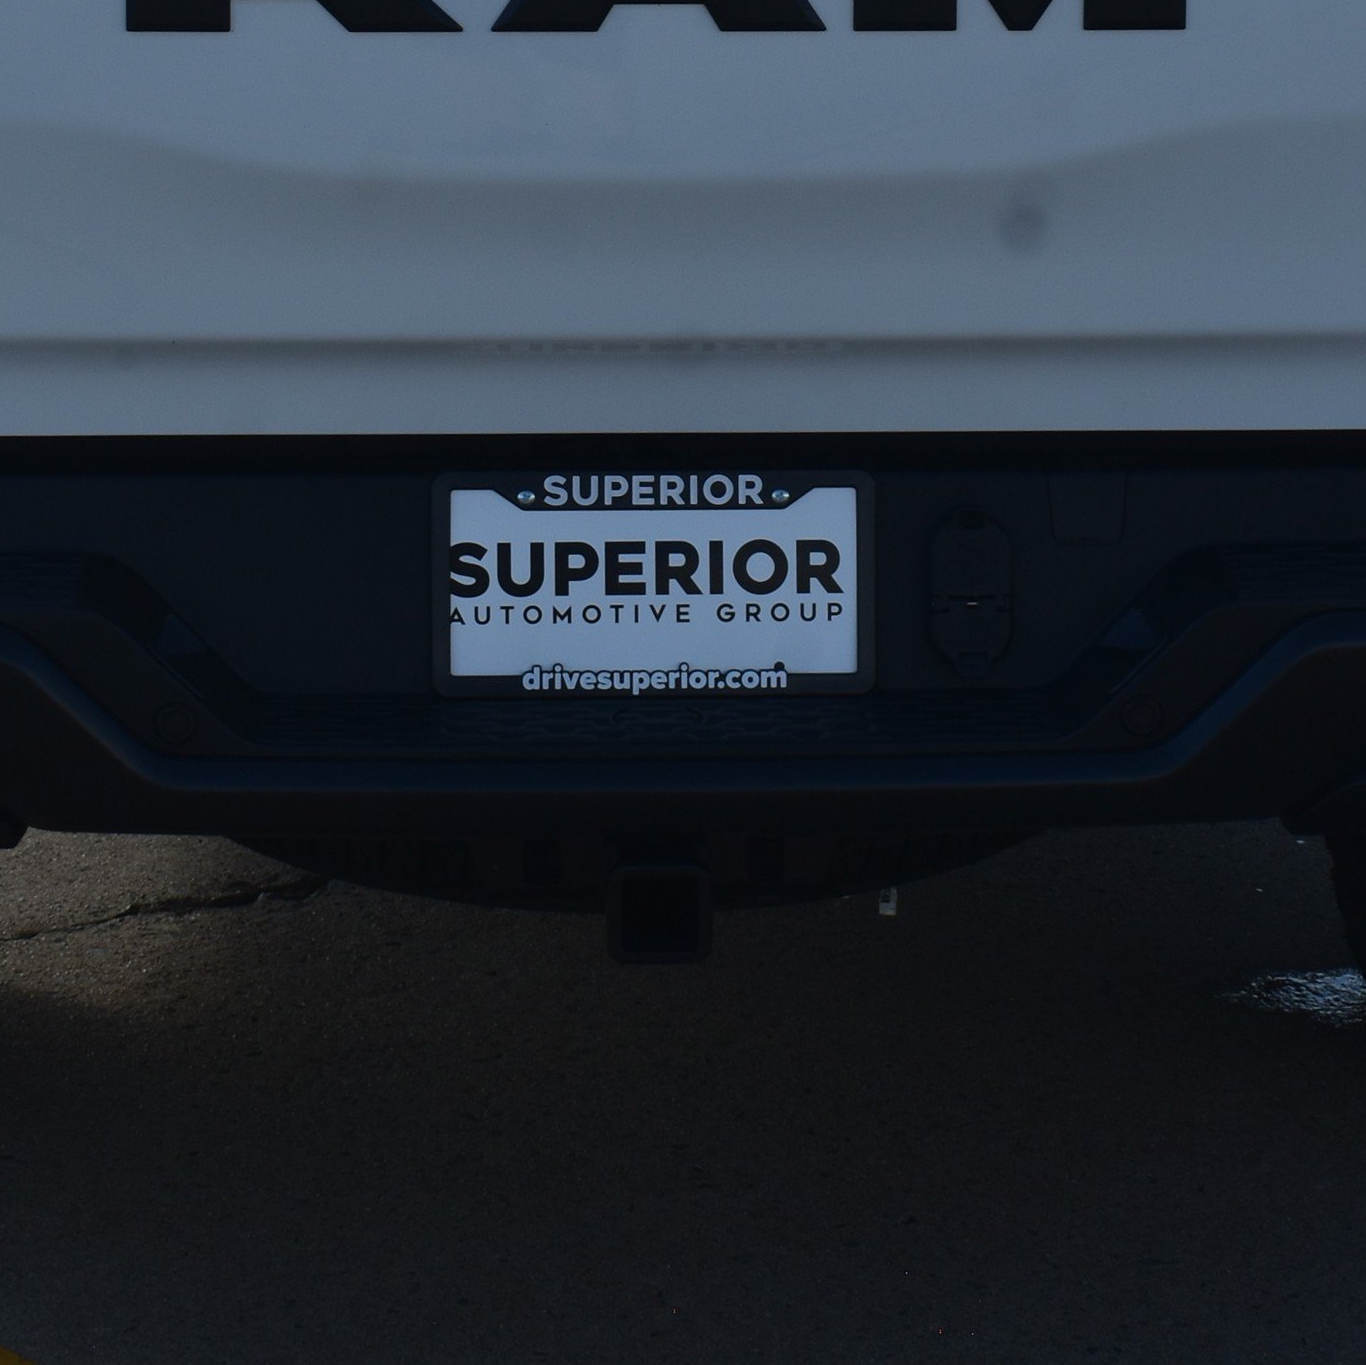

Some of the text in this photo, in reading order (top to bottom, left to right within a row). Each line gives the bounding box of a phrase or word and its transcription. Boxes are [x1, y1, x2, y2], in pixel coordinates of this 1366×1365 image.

[543, 474, 765, 507] SUPERIOR
[449, 538, 845, 599] SUPERIOR
[449, 602, 844, 626] AUTOMOTIVE GROUP
[522, 665, 788, 695] drivesuperior.com
